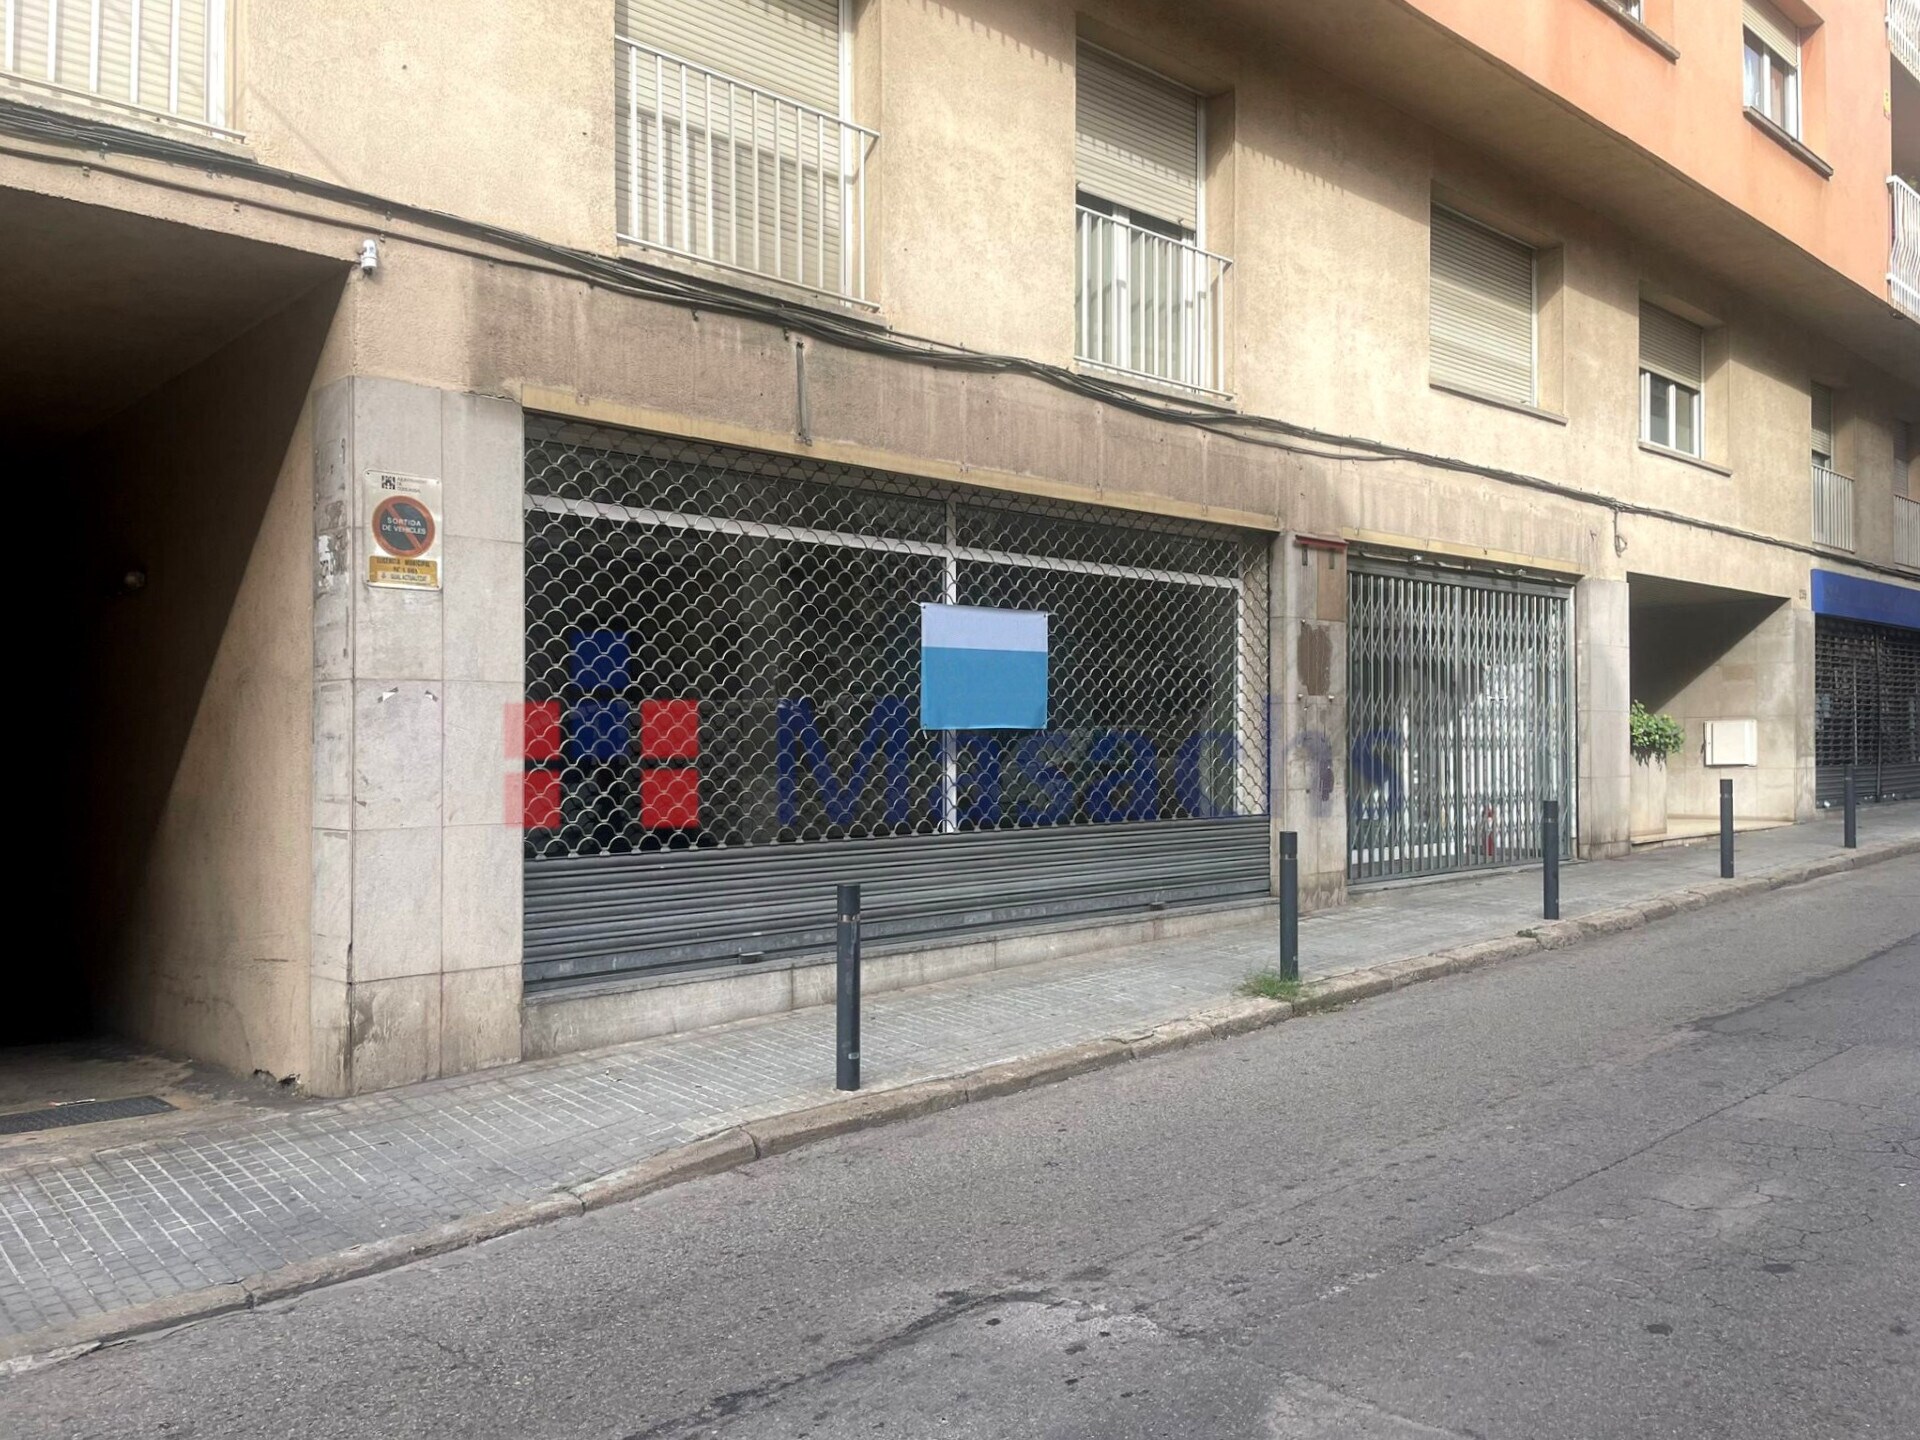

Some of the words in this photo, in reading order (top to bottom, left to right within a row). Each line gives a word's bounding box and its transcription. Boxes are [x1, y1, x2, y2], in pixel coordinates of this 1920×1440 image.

[387, 517, 421, 527] SORTIDA
[382, 524, 393, 532] DE
[394, 525, 426, 535] VEHICLES
